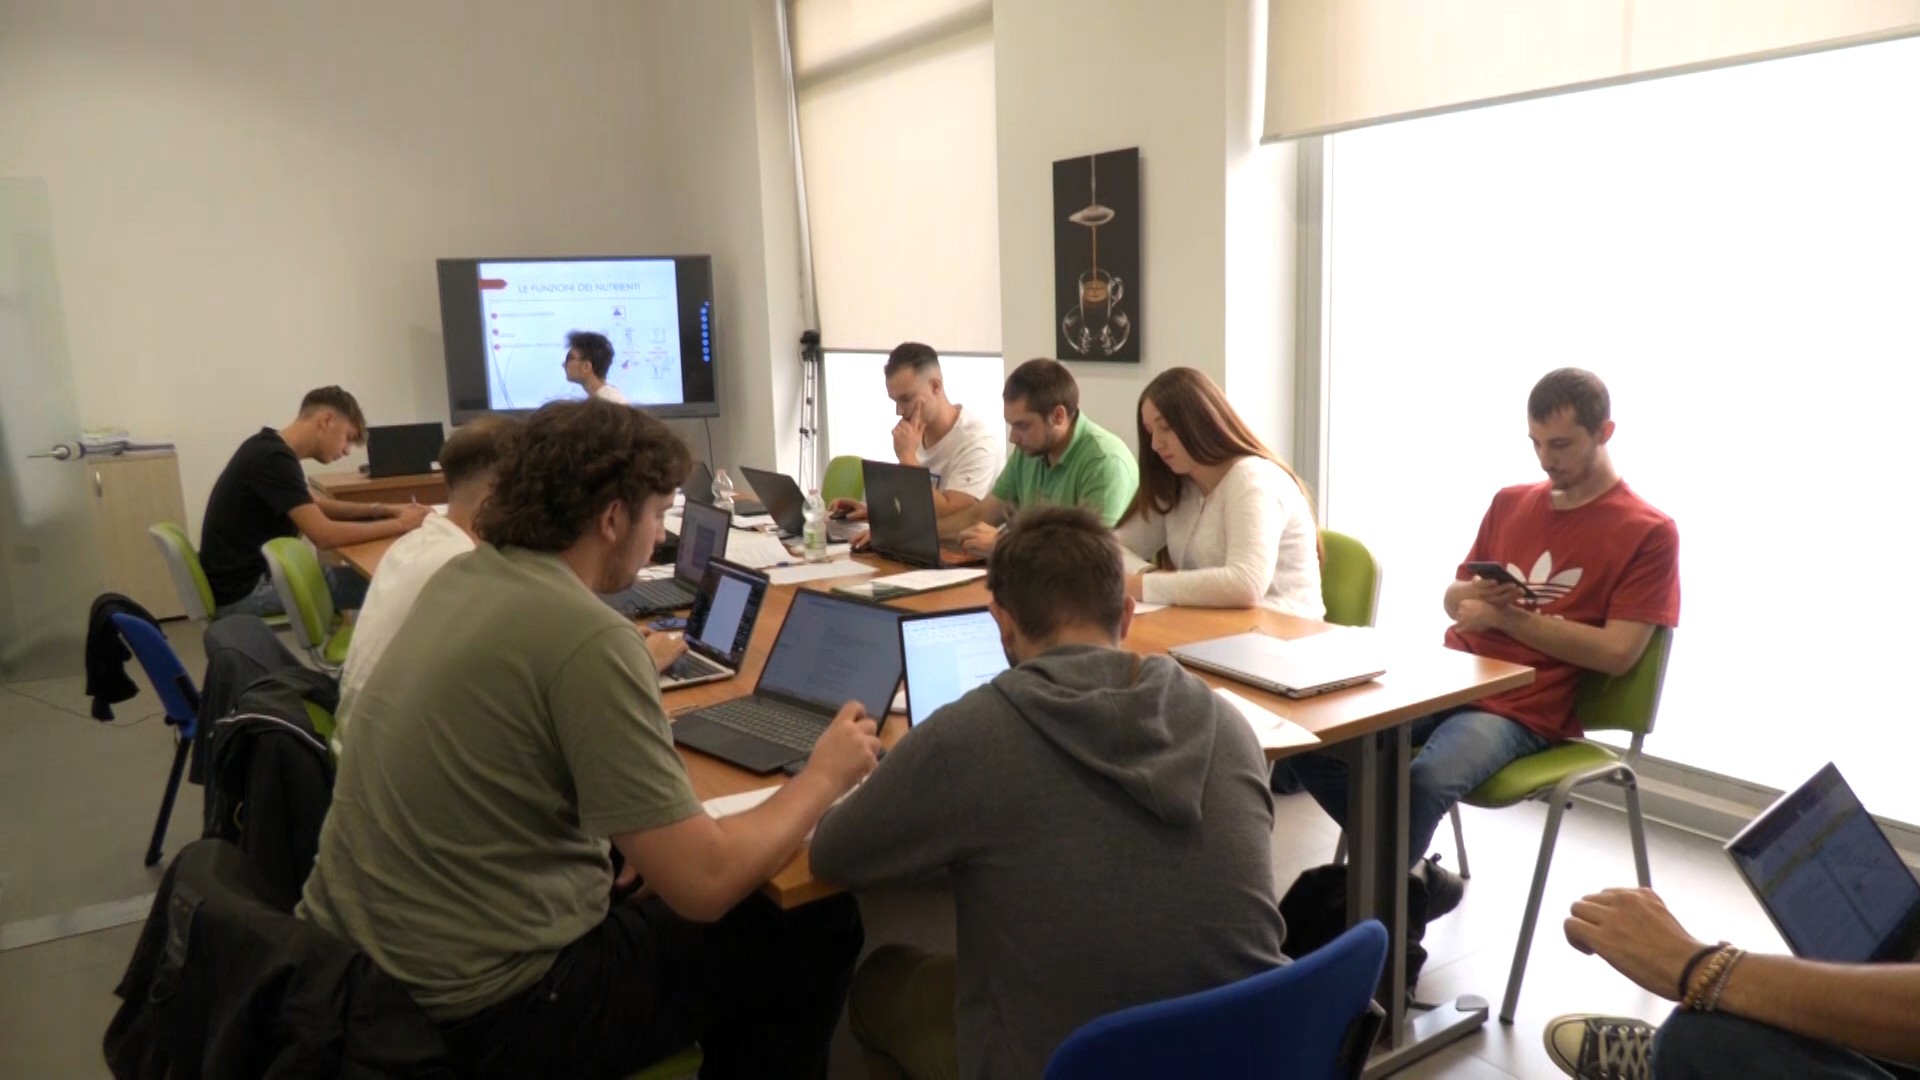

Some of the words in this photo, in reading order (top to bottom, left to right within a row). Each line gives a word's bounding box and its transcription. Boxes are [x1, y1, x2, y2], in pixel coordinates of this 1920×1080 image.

[518, 284, 528, 294] LE
[577, 282, 593, 292] DEI
[595, 281, 641, 292] NUTRIENTI
